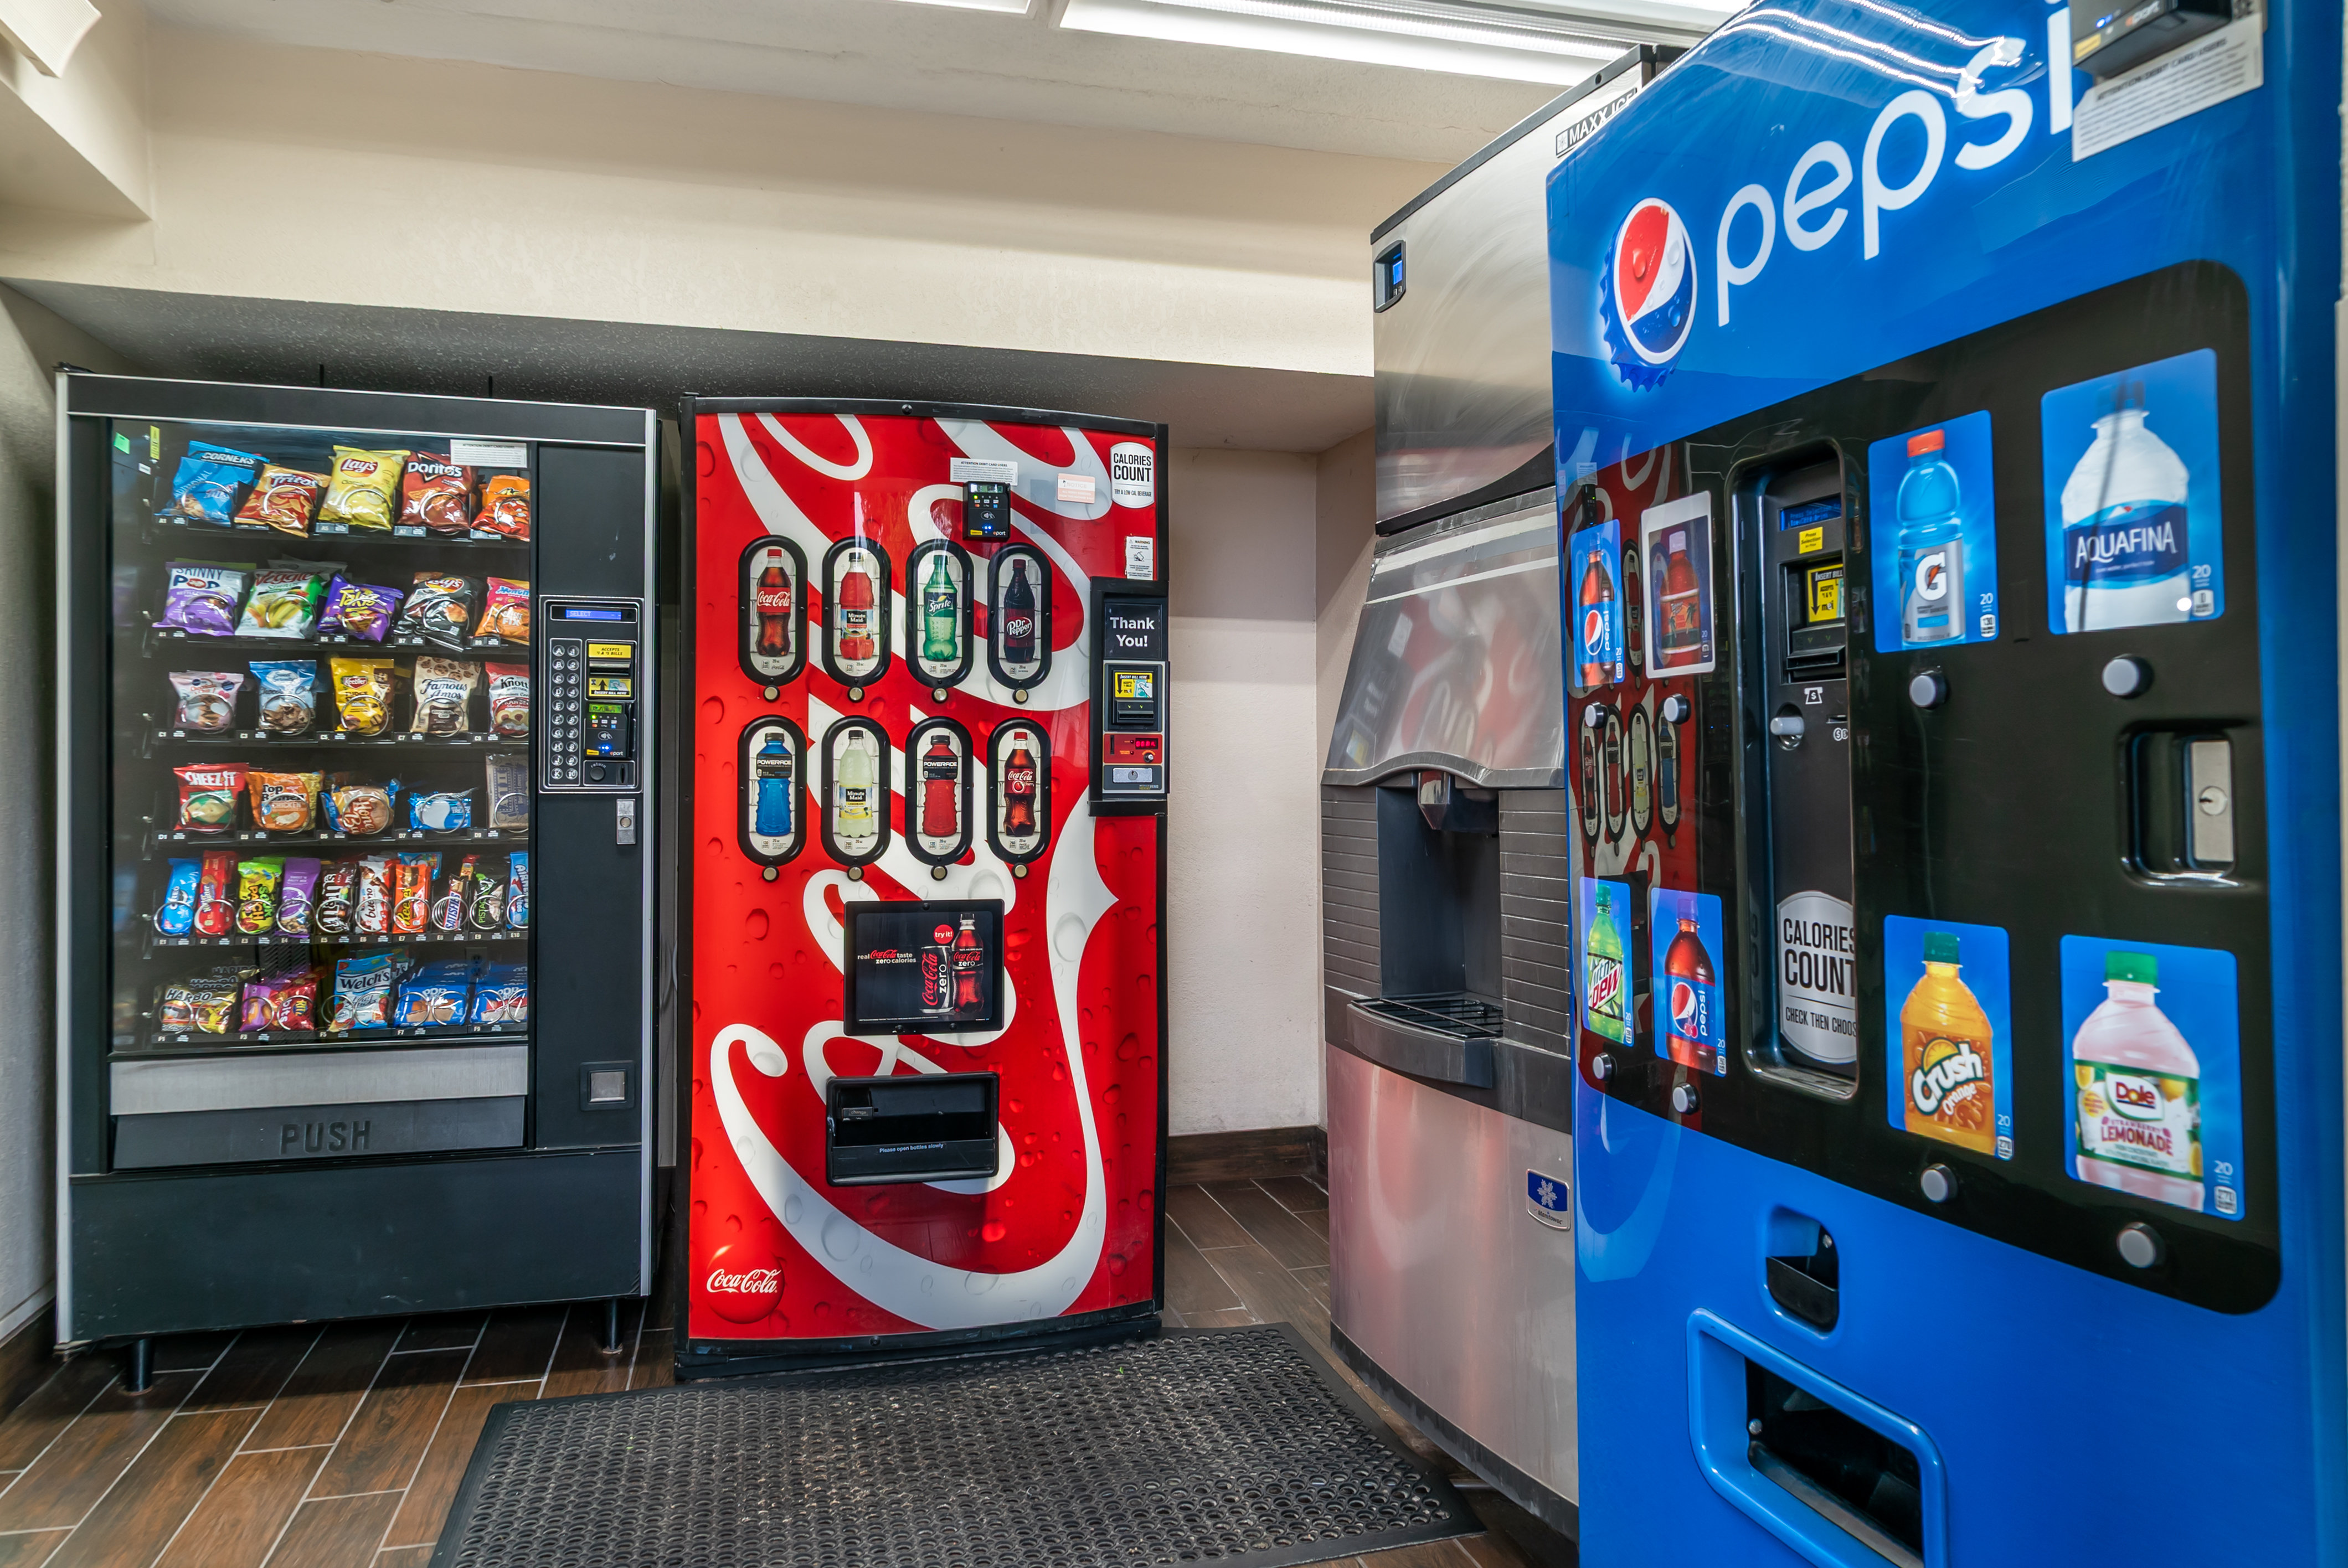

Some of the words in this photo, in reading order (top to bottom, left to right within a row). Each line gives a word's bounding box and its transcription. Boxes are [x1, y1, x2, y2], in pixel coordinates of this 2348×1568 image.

[1716, 0, 2073, 327] pepsi
[202, 451, 256, 465] CORNERS
[341, 458, 378, 472] Lay's
[1114, 453, 1151, 466] CALORIES
[408, 461, 462, 478] Doritos
[1114, 465, 1152, 482] COUNT
[270, 472, 318, 487] Fritos
[2075, 521, 2177, 570] AQUAFINA
[1815, 572, 1832, 581] INSERT
[1915, 551, 1947, 601] G
[2192, 564, 2211, 579] 20
[339, 589, 380, 607] Takis
[757, 591, 791, 607] Coca-Cola
[1980, 592, 1994, 605] 20
[929, 600, 951, 613] Sprite
[1007, 620, 1031, 636] Pepper
[1110, 617, 1155, 630] Thank
[1116, 634, 1148, 647] You!
[1701, 630, 1708, 638] 20
[1615, 647, 1622, 657] 20
[344, 678, 367, 686] Keebler
[420, 679, 468, 694] Famous
[430, 690, 462, 700] Amos
[1008, 770, 1033, 781] Coca-Cola
[262, 784, 284, 795] Top
[365, 888, 378, 919] bueno
[397, 888, 413, 926] Reese's
[445, 891, 462, 930] SATISFIES
[1783, 917, 1855, 954] CALORIES
[871, 950, 898, 959] Coca-Cola
[953, 951, 981, 961] Coca-Cola
[340, 969, 390, 990] Welch's
[921, 952, 938, 1006] Coca-Cola
[939, 964, 947, 994] zero
[1784, 948, 1855, 998] COUNT
[294, 999, 307, 1017] RITZ
[1698, 989, 1708, 1036] pepsi
[1625, 1012, 1631, 1021] 20
[1785, 1007, 1809, 1026] CHECK
[1810, 1012, 1830, 1031] THEN
[1717, 1038, 1725, 1049] 20
[1912, 1041, 1985, 1115] Crush
[1943, 1082, 1977, 1116] orange
[2115, 1081, 2156, 1106] Dole
[1997, 1113, 2011, 1127] 20
[279, 1120, 372, 1156] PUSH
[2101, 1125, 2174, 1157] LEMONADE
[2213, 1159, 2233, 1175] 20
[1538, 1210, 1563, 1225] Manitowoc
[707, 1268, 782, 1293] Coca-Cola
